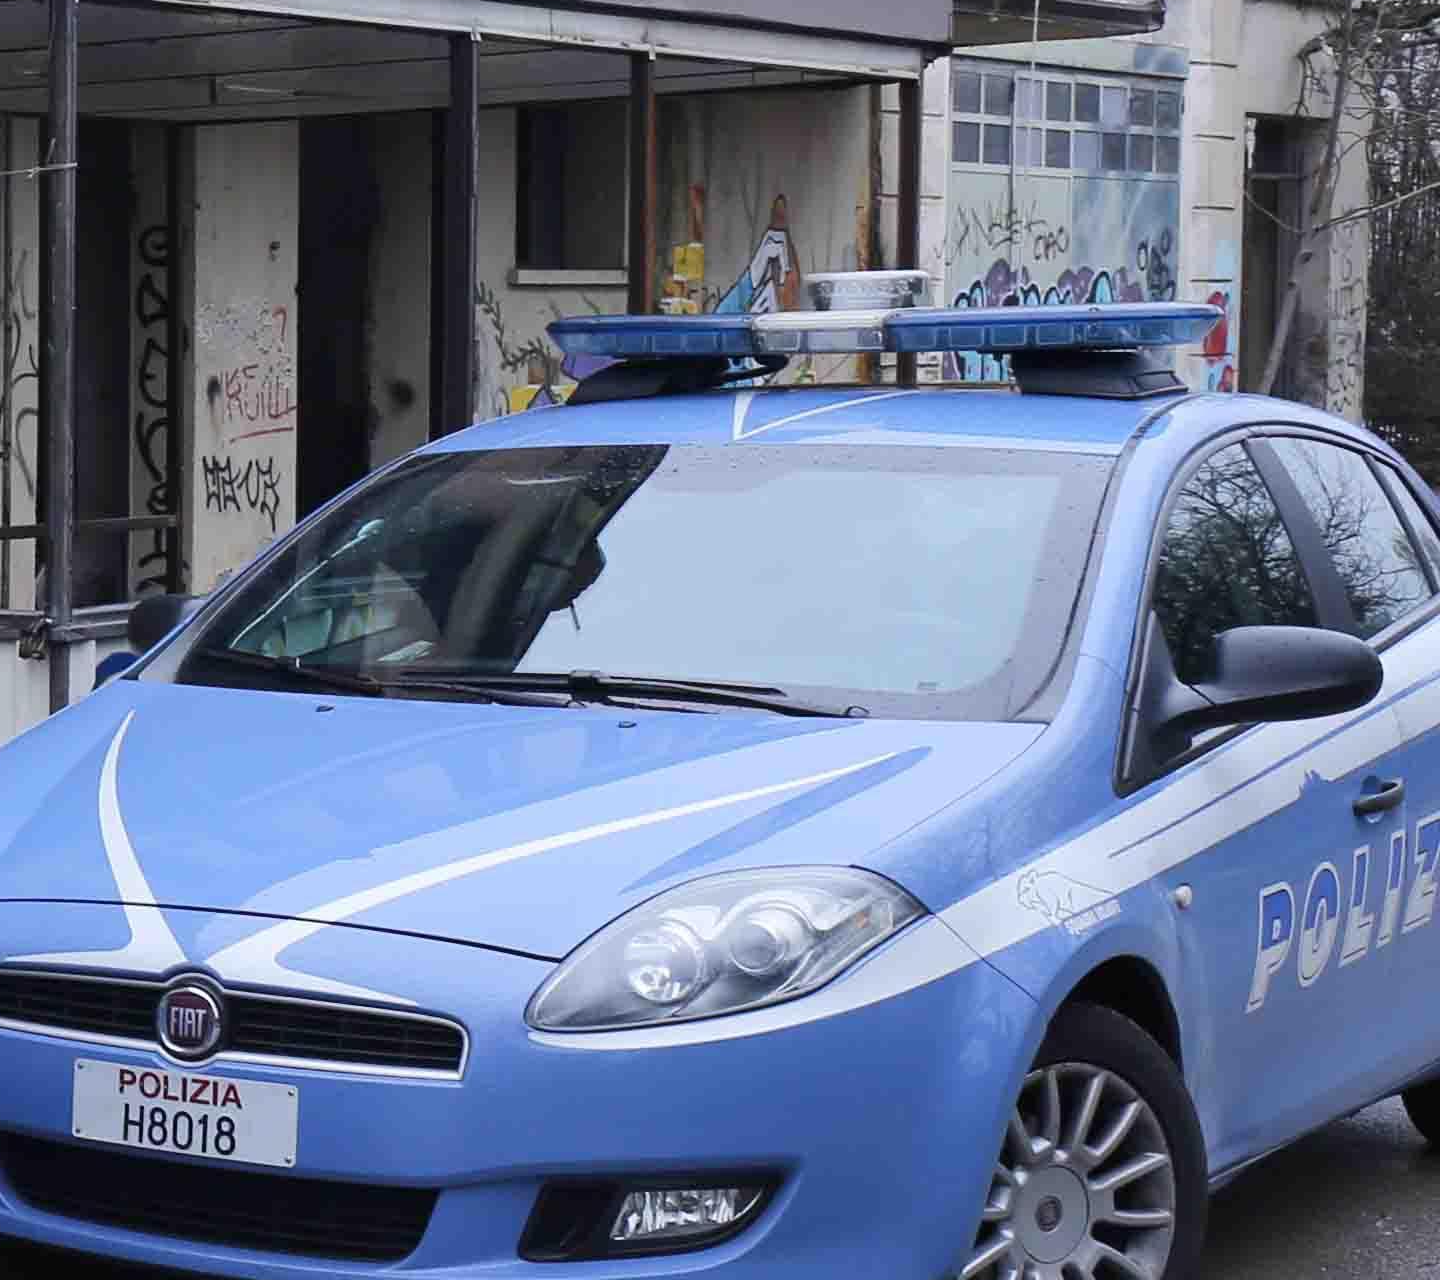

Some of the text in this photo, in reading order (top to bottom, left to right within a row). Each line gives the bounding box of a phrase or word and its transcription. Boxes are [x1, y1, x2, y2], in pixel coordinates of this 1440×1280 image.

[169, 1006, 207, 1038] FIAT
[118, 1068, 243, 1109] POLIZIA
[122, 1103, 236, 1155] H8018
